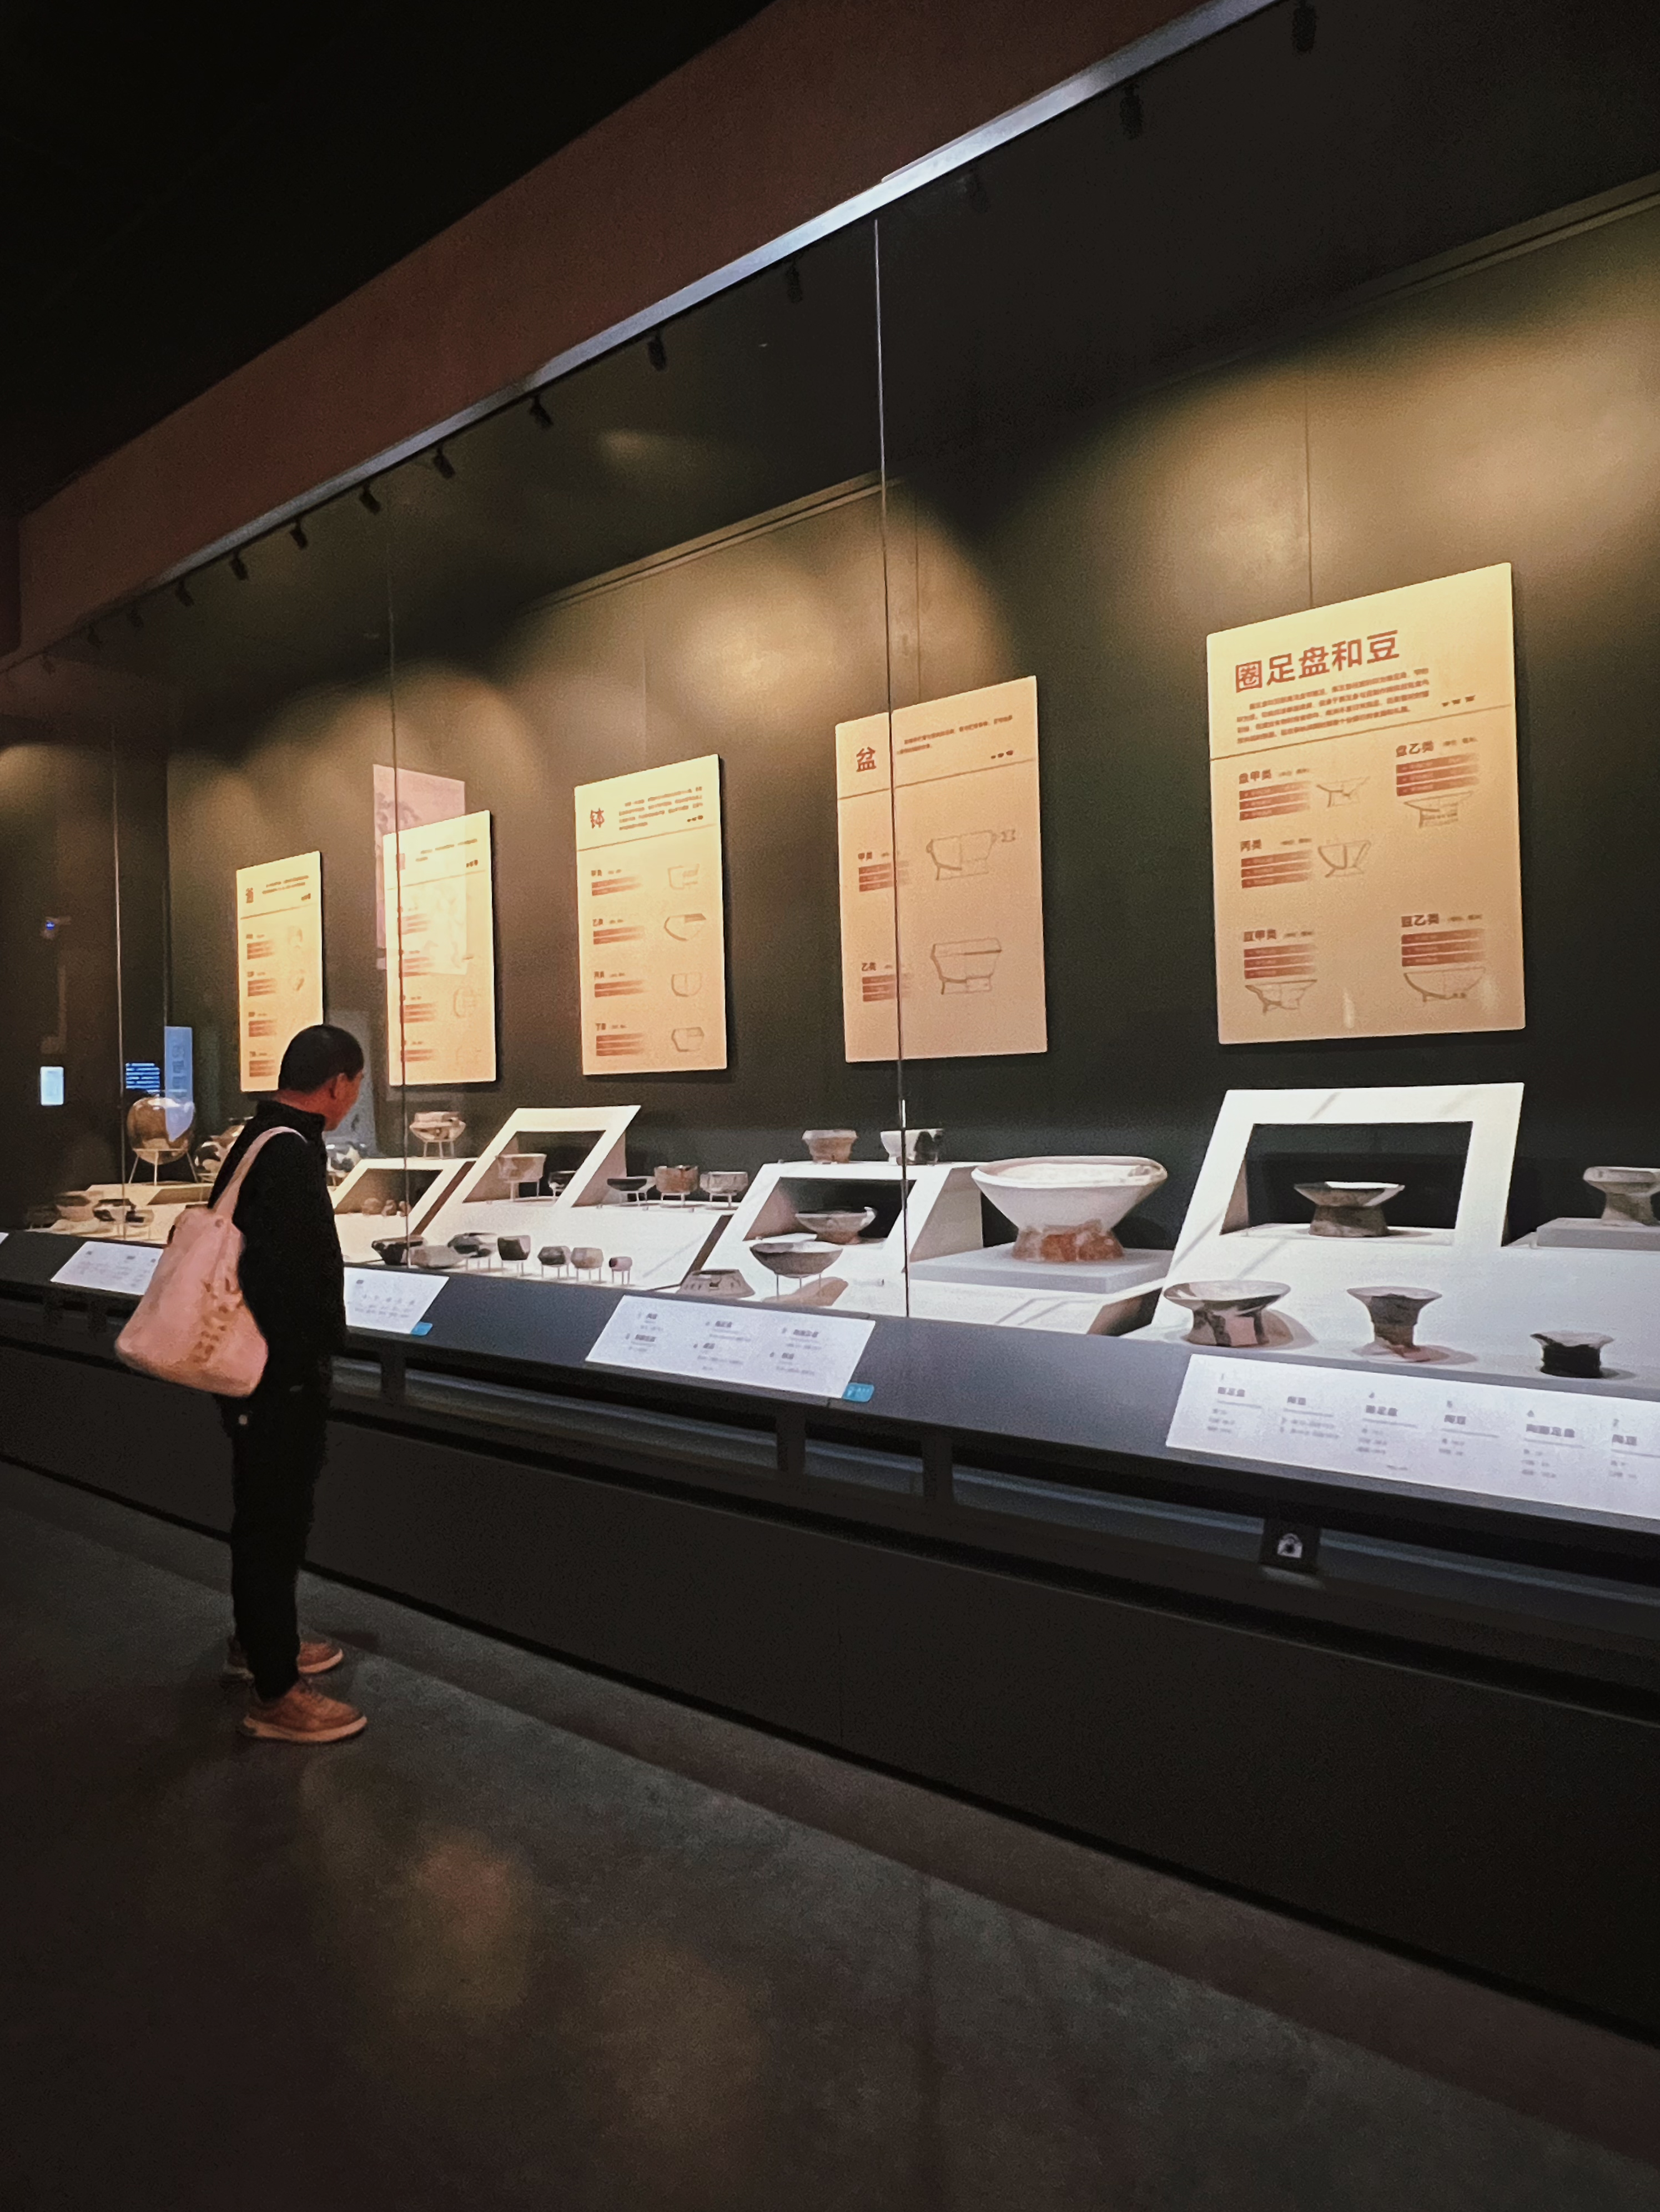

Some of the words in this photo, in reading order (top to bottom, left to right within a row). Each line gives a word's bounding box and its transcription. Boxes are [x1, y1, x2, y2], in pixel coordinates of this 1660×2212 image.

[1235, 629, 1400, 693] 圈足盘和豆
[856, 746, 877, 772] 盆
